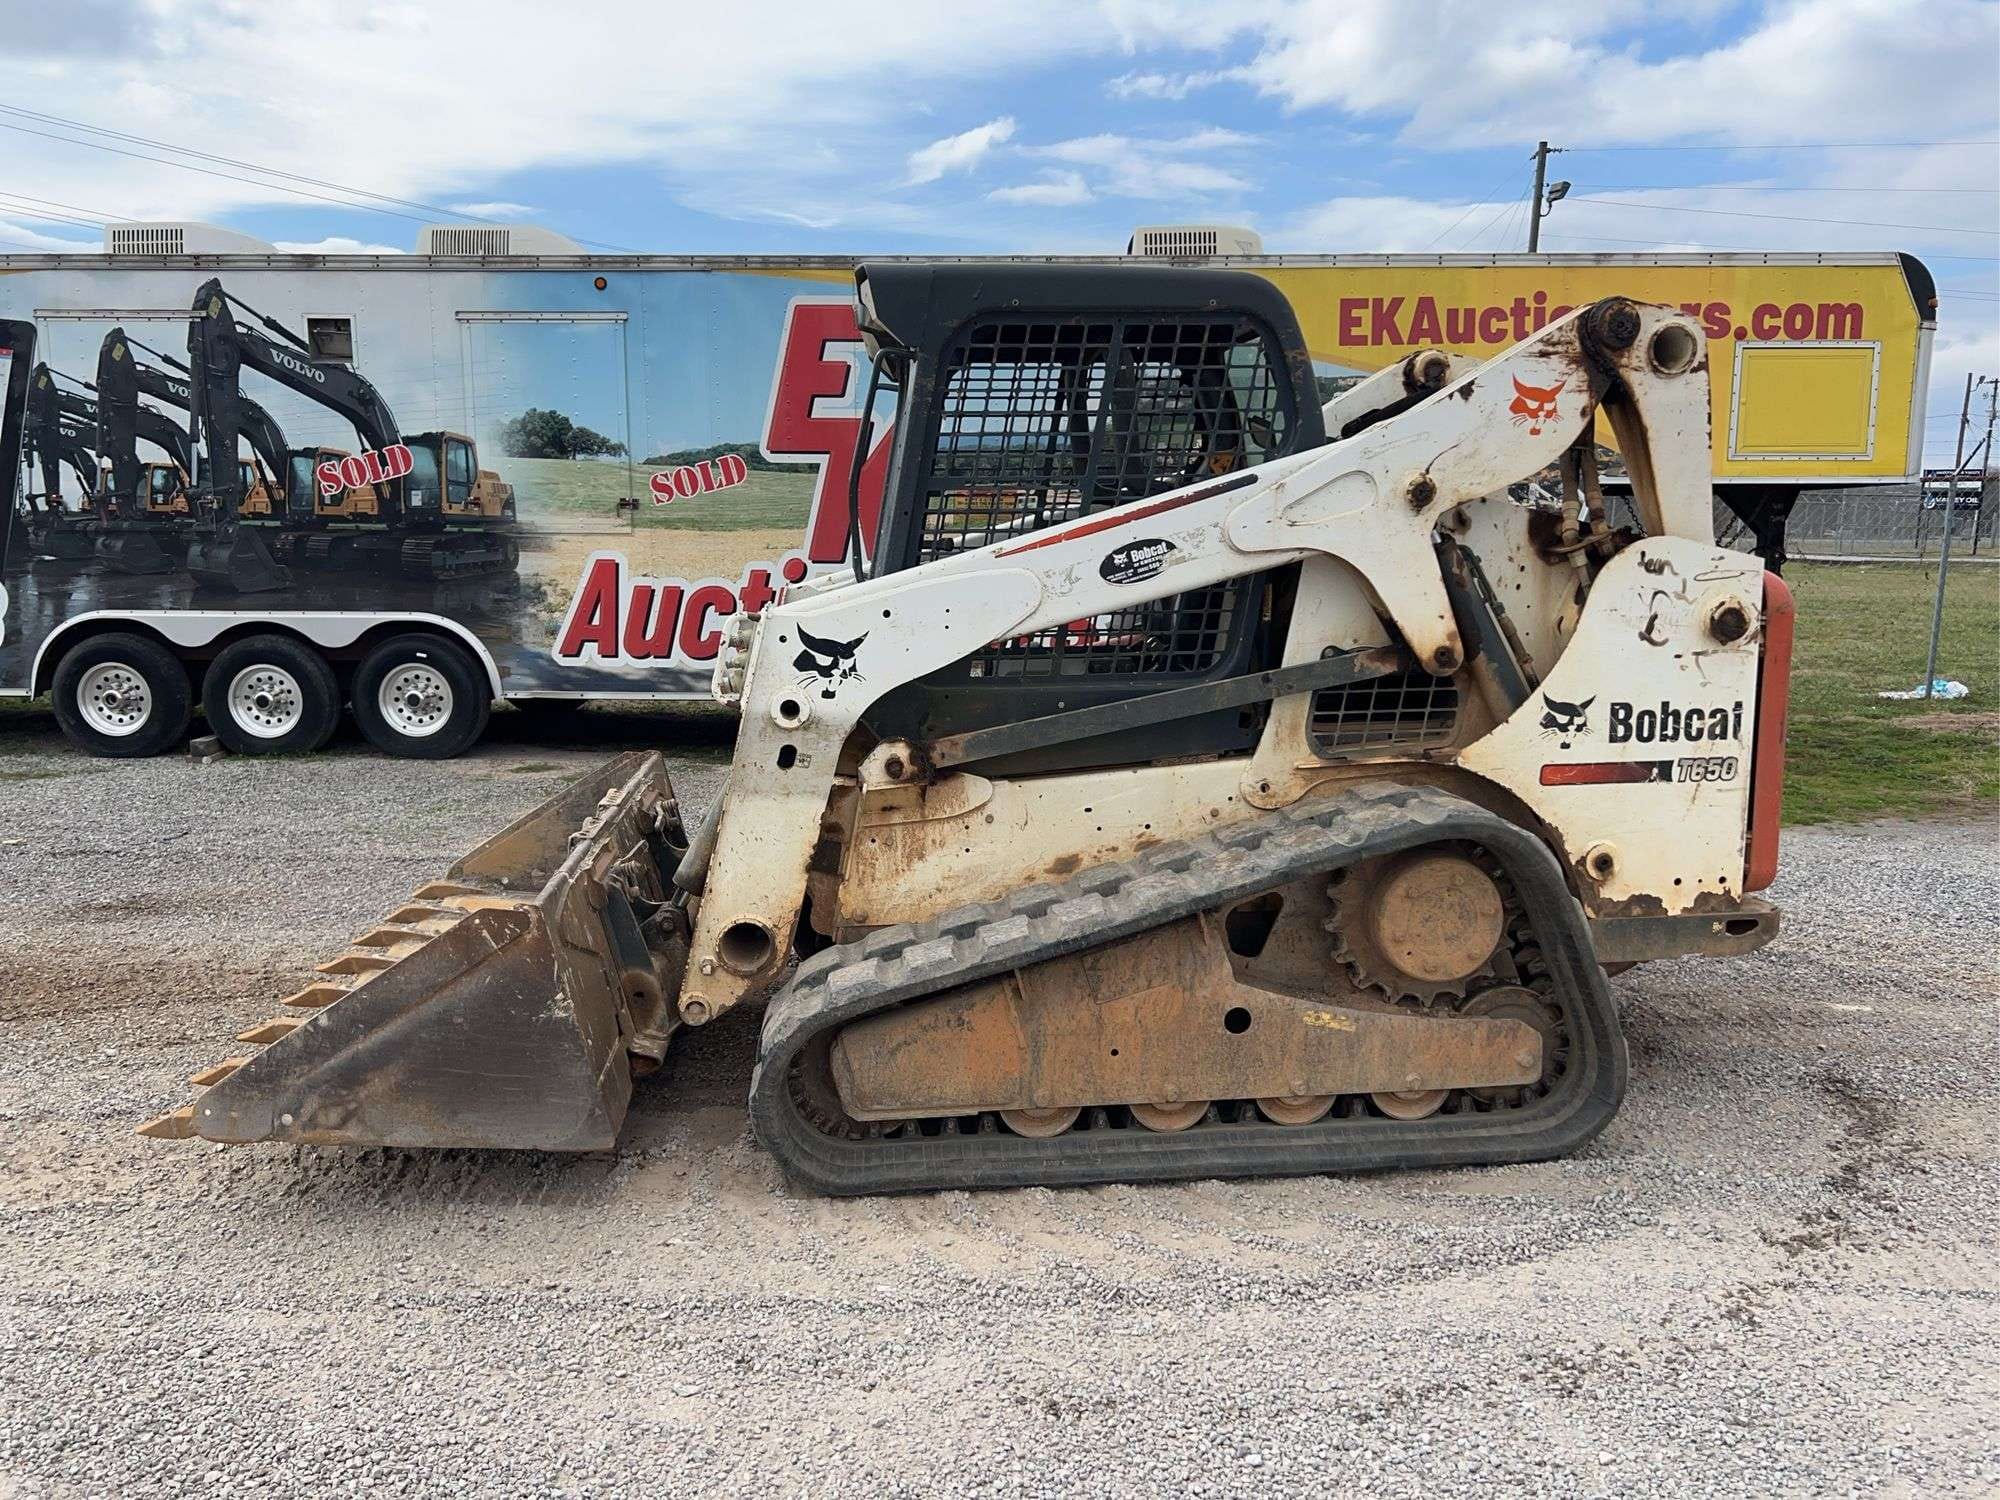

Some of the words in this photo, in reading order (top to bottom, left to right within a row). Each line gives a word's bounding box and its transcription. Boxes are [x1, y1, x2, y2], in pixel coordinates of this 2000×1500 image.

[269, 347, 326, 384] VOLVO
[316, 444, 415, 497] SOLD
[649, 453, 748, 506] SOLD
[1130, 541, 1168, 563] Bobcat
[1608, 700, 1744, 744] Bobcat
[1676, 757, 1740, 782] T650
